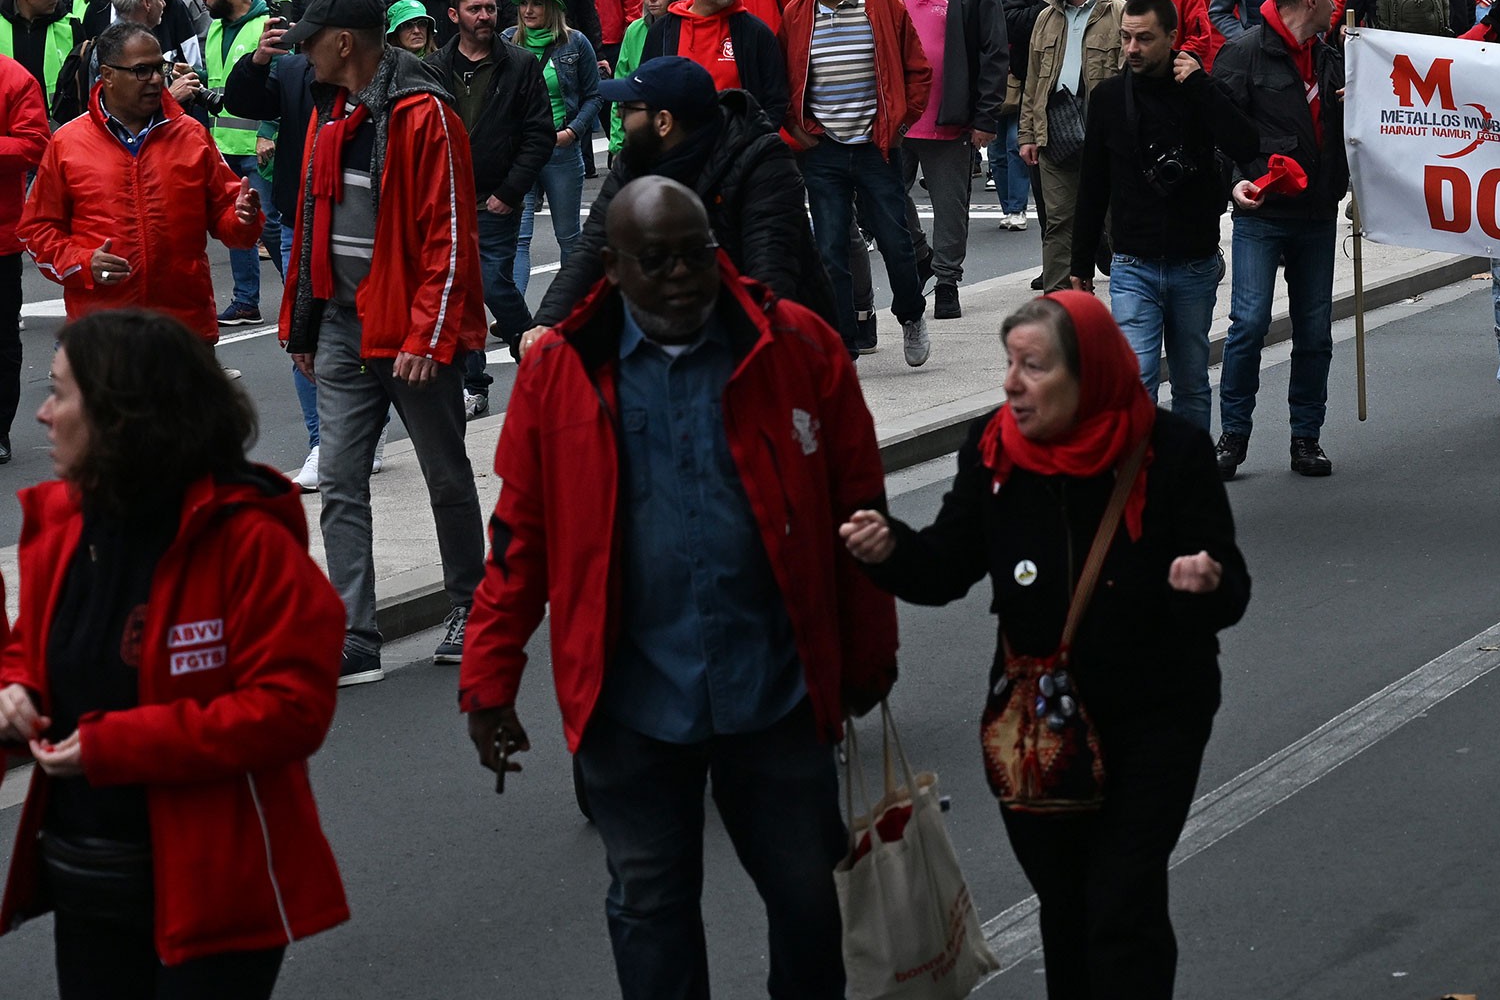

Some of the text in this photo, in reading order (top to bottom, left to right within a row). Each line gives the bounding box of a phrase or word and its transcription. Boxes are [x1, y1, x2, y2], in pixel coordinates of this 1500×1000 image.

[1381, 109, 1500, 133] METALLOS MWB
[1380, 125, 1471, 140] HAINAUT NAMUR
[1478, 131, 1500, 141] FGTB
[172, 622, 220, 644] ABVV
[175, 650, 223, 670] FGTB
